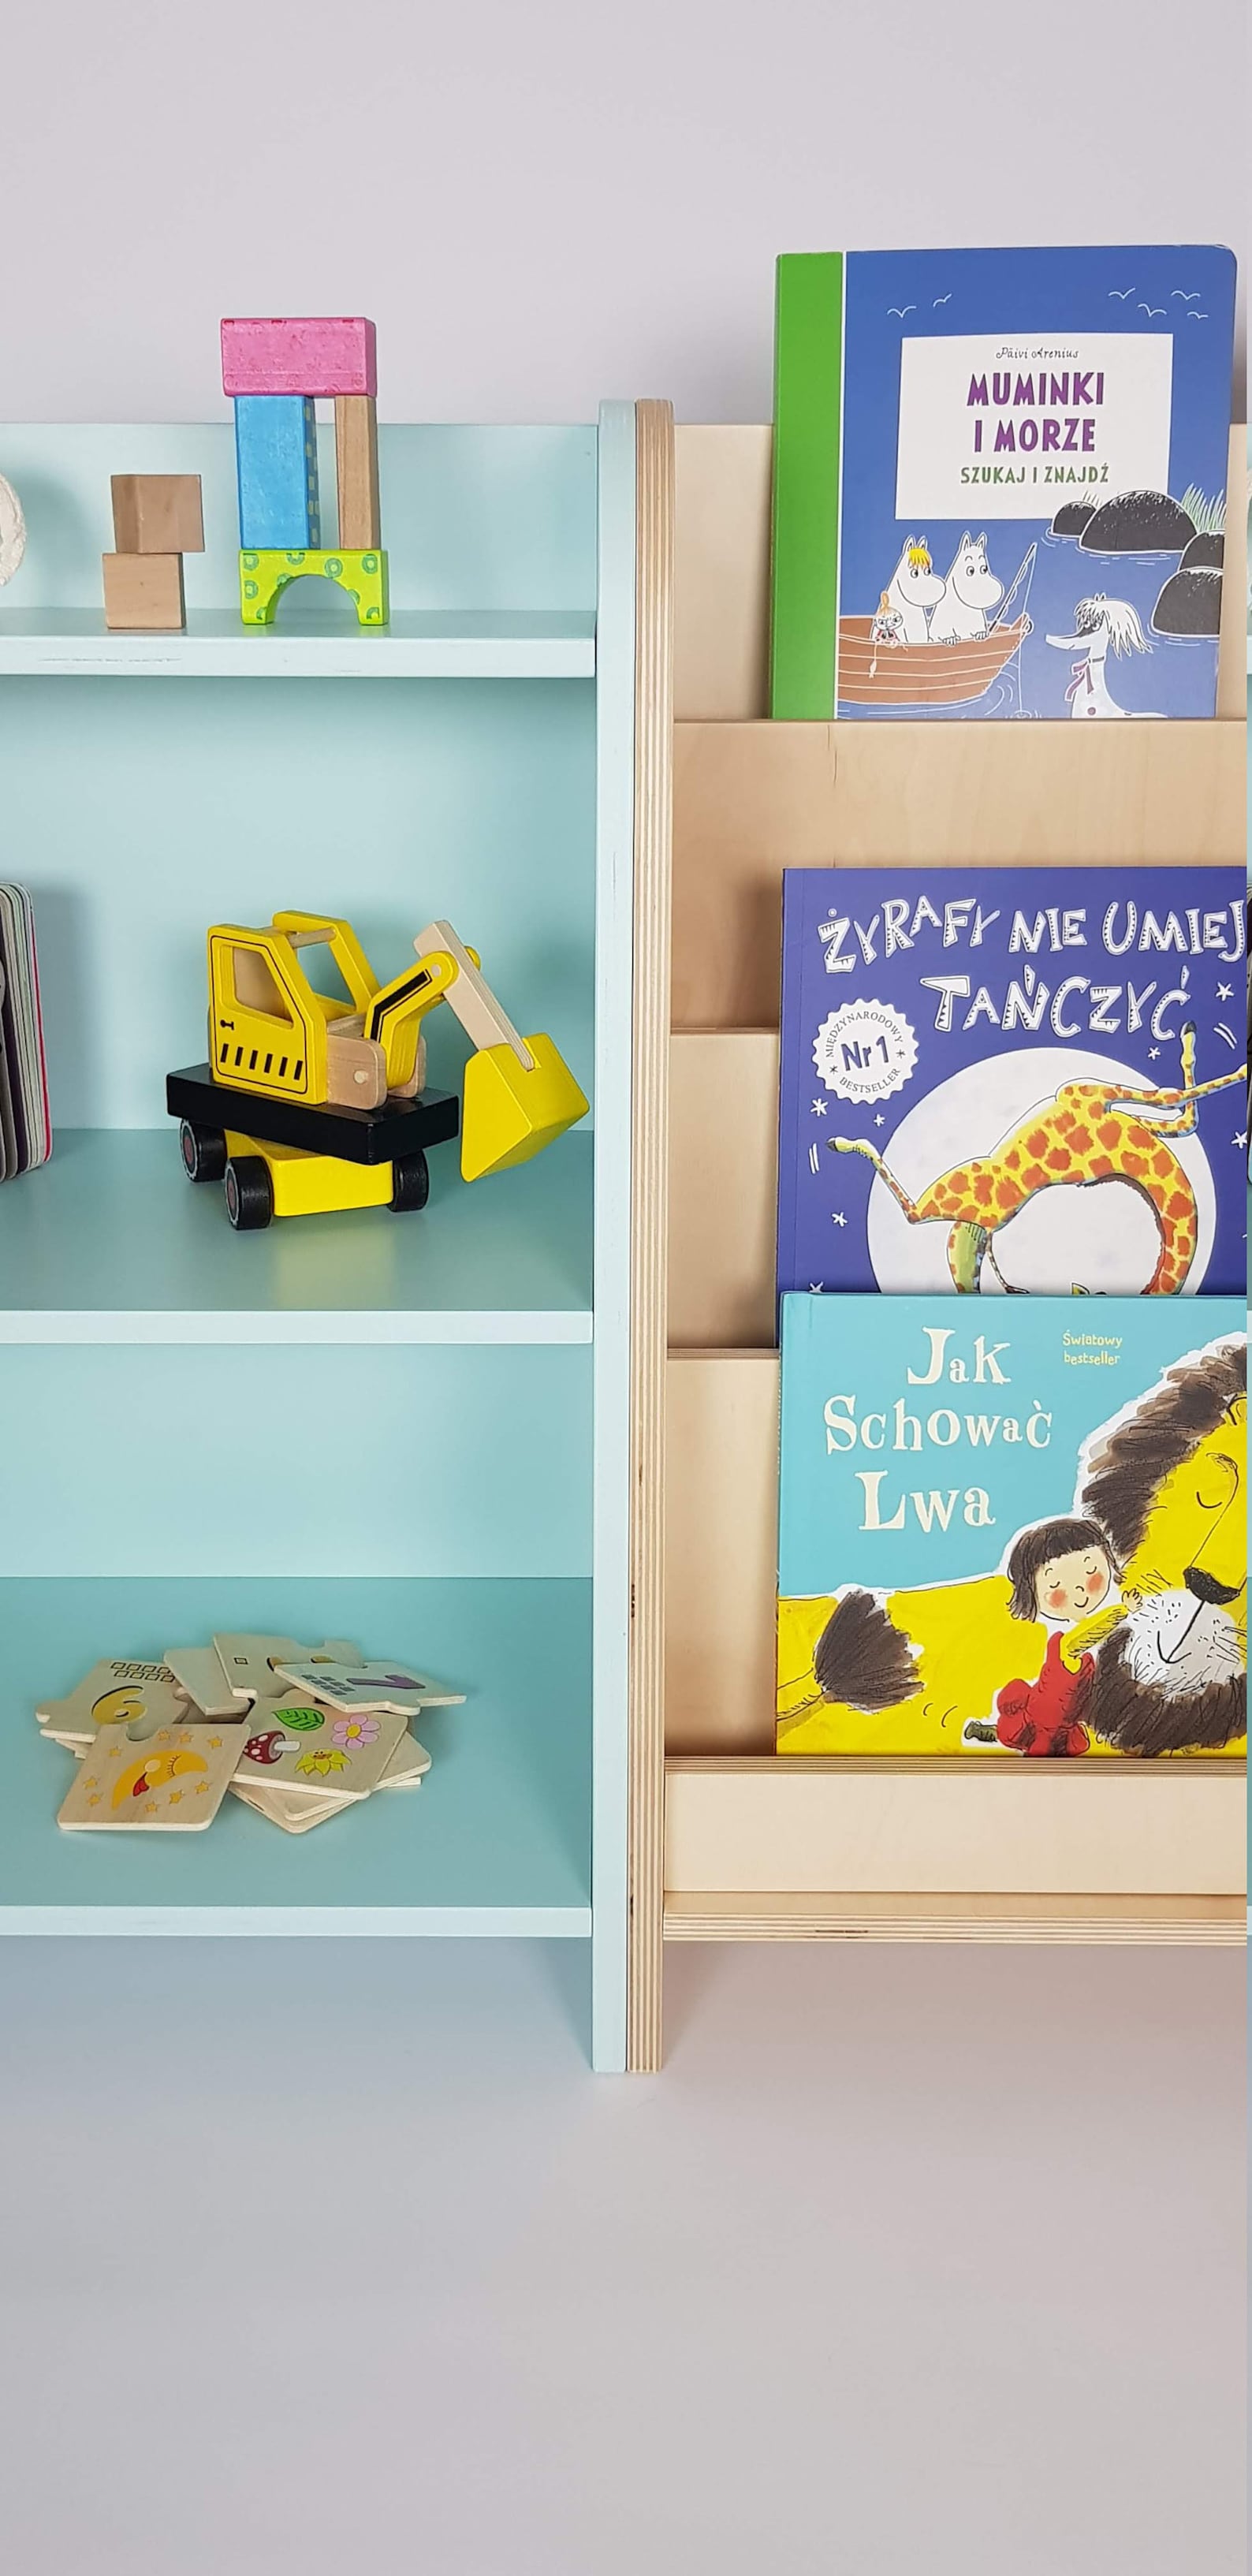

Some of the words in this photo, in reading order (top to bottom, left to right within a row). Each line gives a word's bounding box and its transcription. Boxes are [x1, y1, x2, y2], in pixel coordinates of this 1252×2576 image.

[1031, 346, 1079, 359] Arenius
[967, 371, 1104, 406] MUMINKI
[974, 419, 982, 453] I
[993, 418, 1096, 453] MORZE
[960, 466, 1025, 484] SZUKAJ
[1033, 466, 1038, 483] I
[1044, 462, 1109, 483] ZNAJDŹ
[818, 894, 1000, 973] ŻYRAFY
[1008, 907, 1086, 954] NIE
[1102, 900, 1245, 963] UMIEJ
[919, 964, 1191, 1042] TAŃCZYĆ
[825, 1011, 904, 1057] MIĘDZYNARODOWY
[840, 1041, 872, 1072] Nr
[875, 1035, 889, 1063] 1
[839, 1068, 900, 1094] BESTSELLER
[906, 1326, 1012, 1385] Jak
[1062, 1329, 1123, 1349] Światowy
[1064, 1350, 1121, 1366] bestseller
[854, 1469, 997, 1534] Lwa
